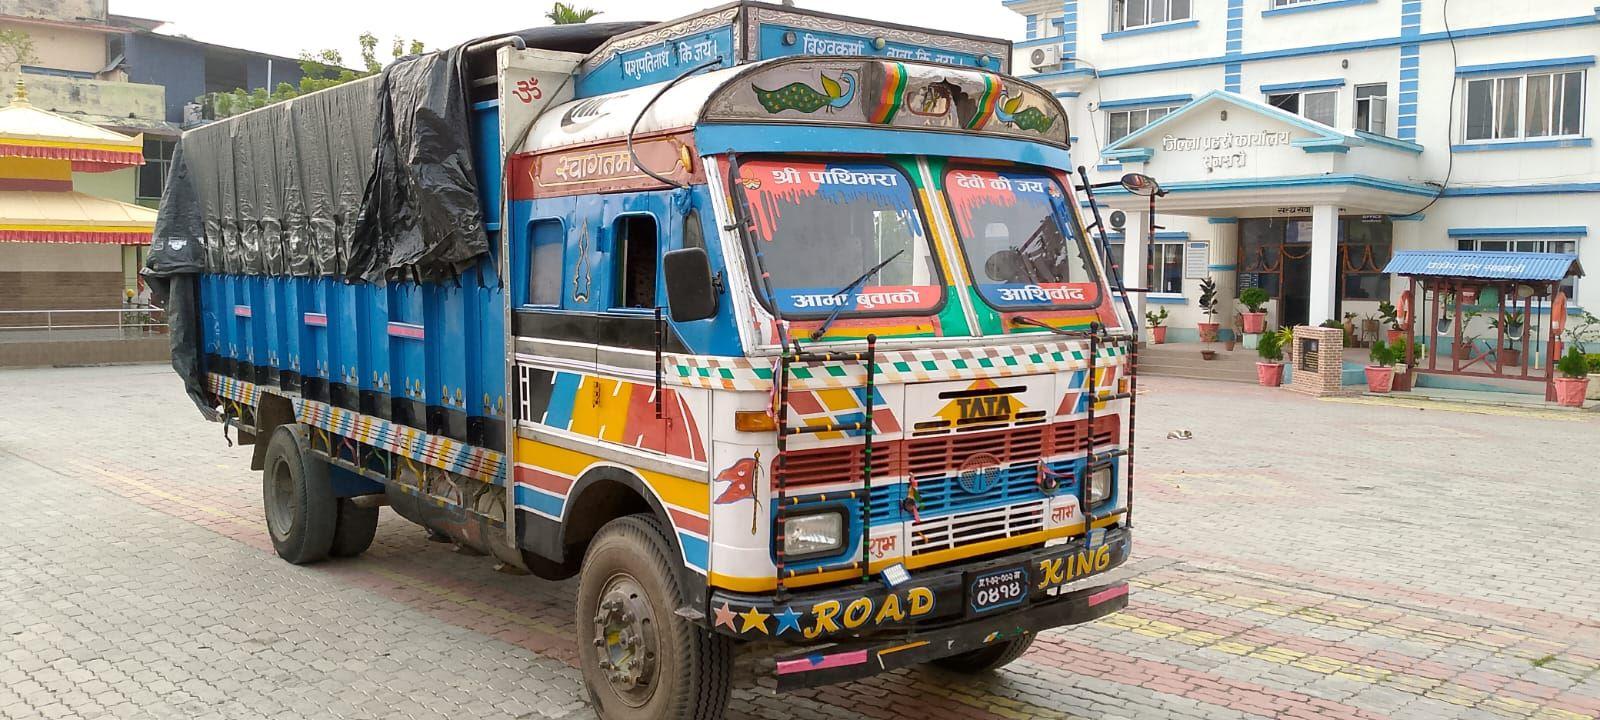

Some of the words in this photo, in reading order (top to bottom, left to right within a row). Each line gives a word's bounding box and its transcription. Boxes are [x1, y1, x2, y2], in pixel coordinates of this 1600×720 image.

[1163, 134, 1201, 151] जिल्ला
[1201, 131, 1233, 151] प्रहरी
[1235, 130, 1291, 148] कार्यालय
[1203, 151, 1247, 173] सुनसरी
[772, 167, 801, 184] श्री
[808, 167, 898, 187] पाथिभरा
[956, 172, 986, 189] देवी
[987, 176, 1013, 191] की
[1015, 180, 1045, 193] जय
[791, 293, 849, 308] आमा
[855, 288, 921, 309] बुवाको
[997, 284, 1085, 301] आशिर्वाद
[957, 395, 1011, 418] TATA
[1052, 504, 1076, 524] लाभ
[803, 586, 937, 639] ROAD
[1038, 544, 1111, 590] KING
[977, 582, 1021, 606] ०४१४
